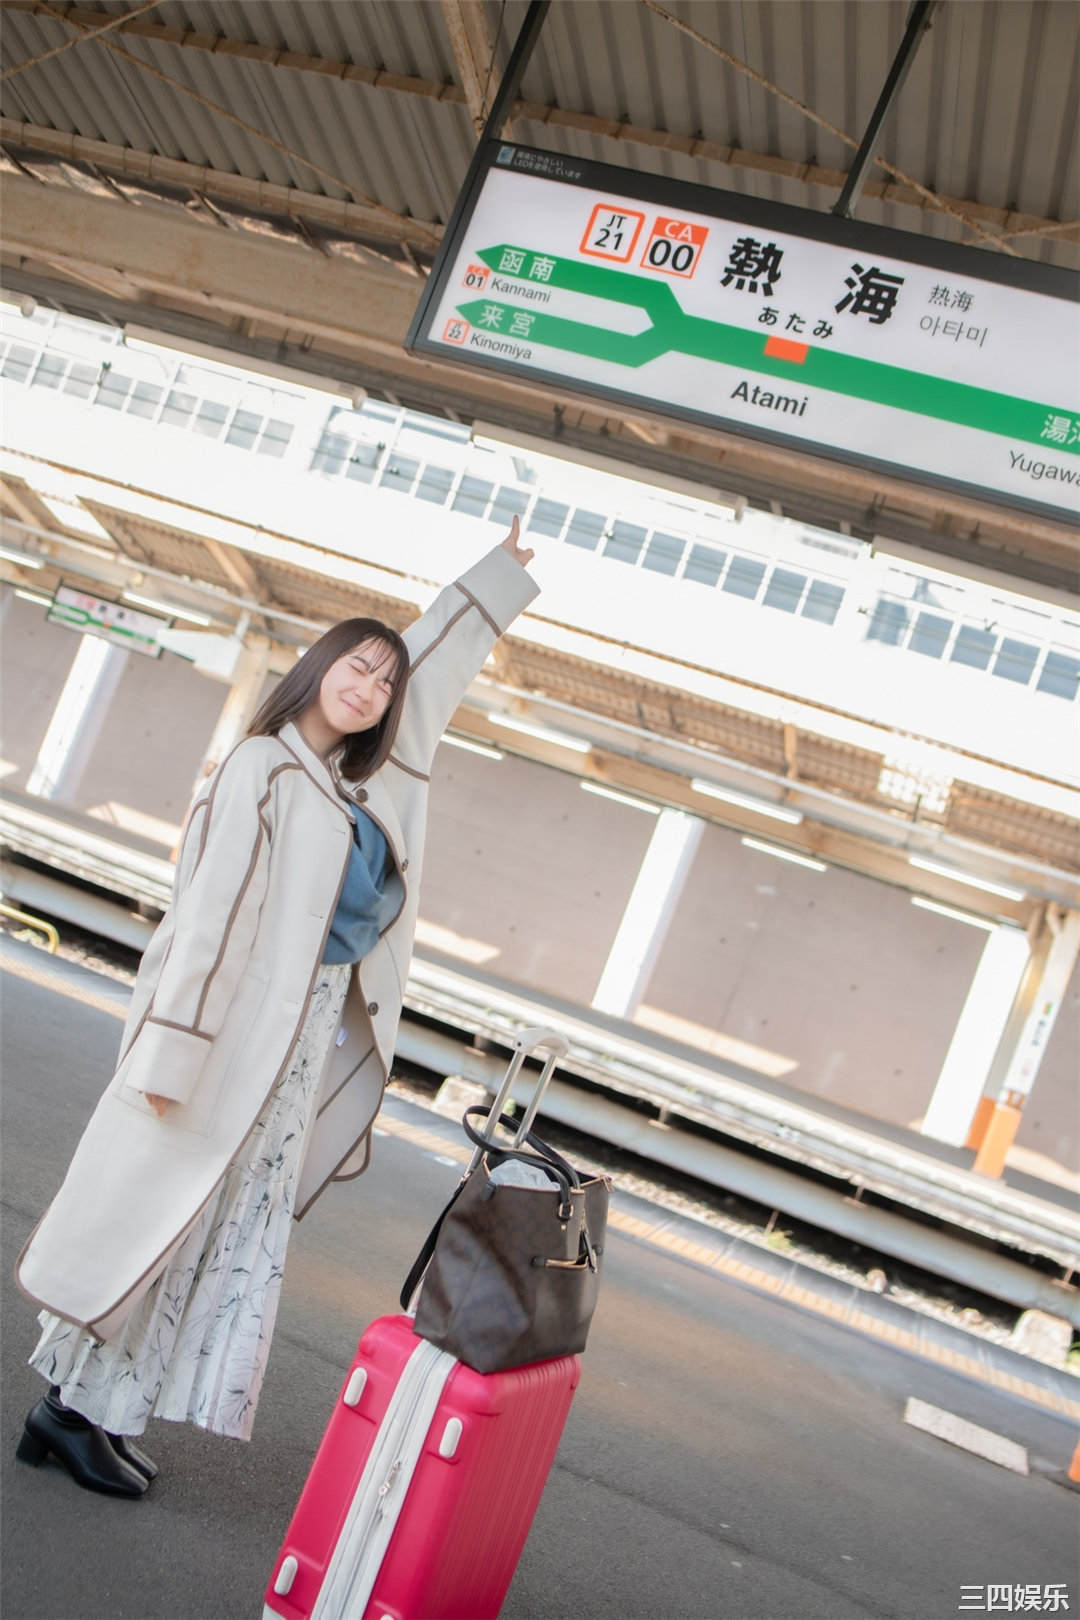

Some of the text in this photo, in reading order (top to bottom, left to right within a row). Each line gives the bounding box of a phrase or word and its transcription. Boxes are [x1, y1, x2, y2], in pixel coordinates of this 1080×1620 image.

[606, 213, 627, 229] JT
[664, 221, 694, 242] CA
[594, 229, 623, 251] 21
[498, 248, 556, 282] 函南
[649, 239, 694, 272] 00
[466, 274, 484, 288] 01
[490, 277, 552, 303] Kannami
[720, 237, 905, 325] 熱海
[928, 284, 974, 312] 热海
[448, 329, 461, 339] 22
[479, 303, 536, 338] 来宮
[757, 306, 834, 339] あたみ
[919, 315, 989, 348] 아타미
[470, 332, 532, 360] Kinomiya
[730, 380, 809, 417] Atami
